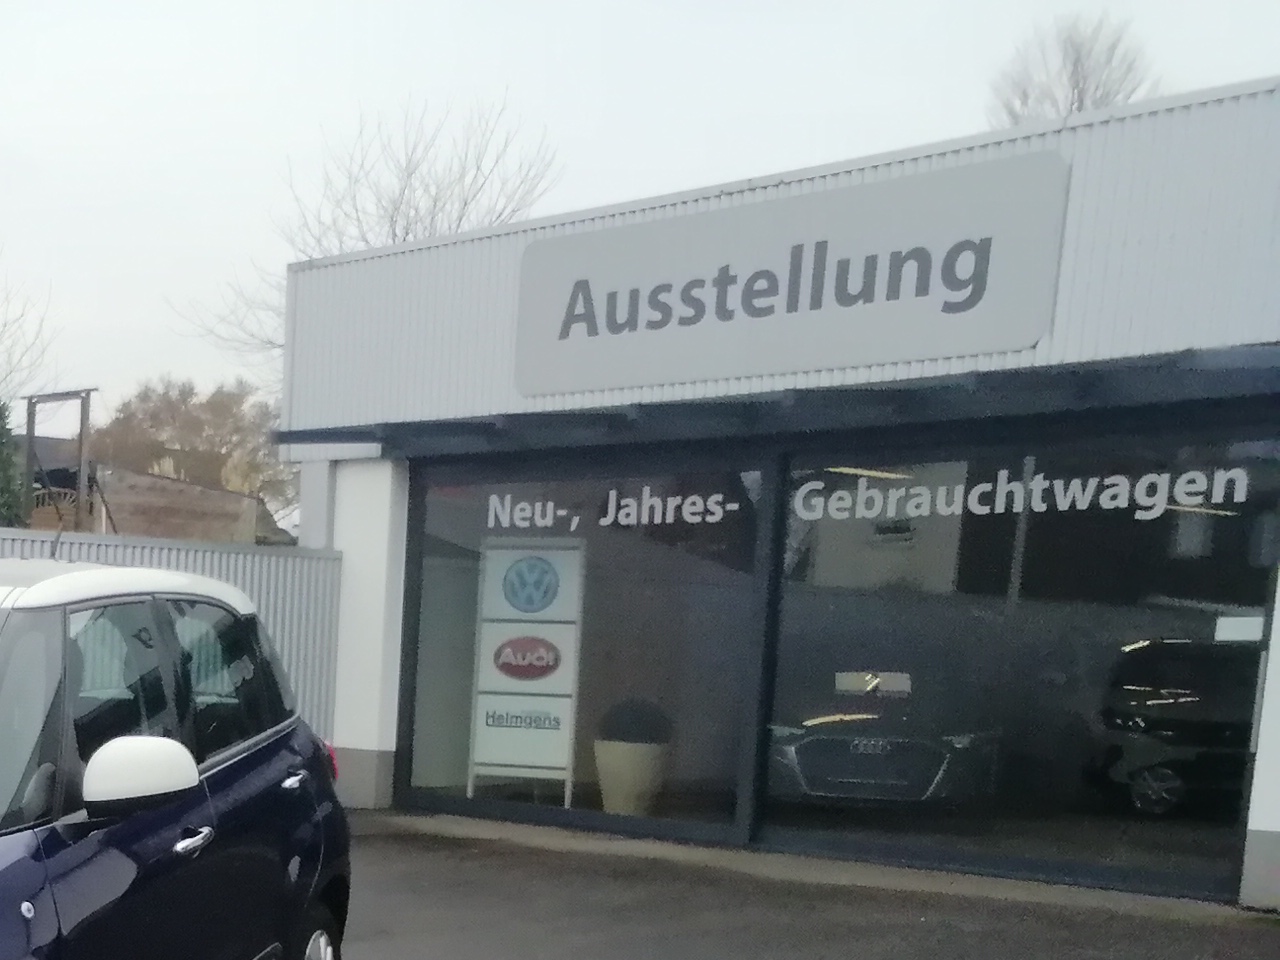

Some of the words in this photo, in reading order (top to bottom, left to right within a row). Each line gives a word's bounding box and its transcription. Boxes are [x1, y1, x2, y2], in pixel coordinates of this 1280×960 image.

[558, 237, 993, 341] Ausstellung
[487, 493, 580, 532] Neu-,
[598, 485, 740, 527] Jahres-
[792, 466, 1250, 521] Gebrauchtwagen
[498, 648, 558, 667] Audi
